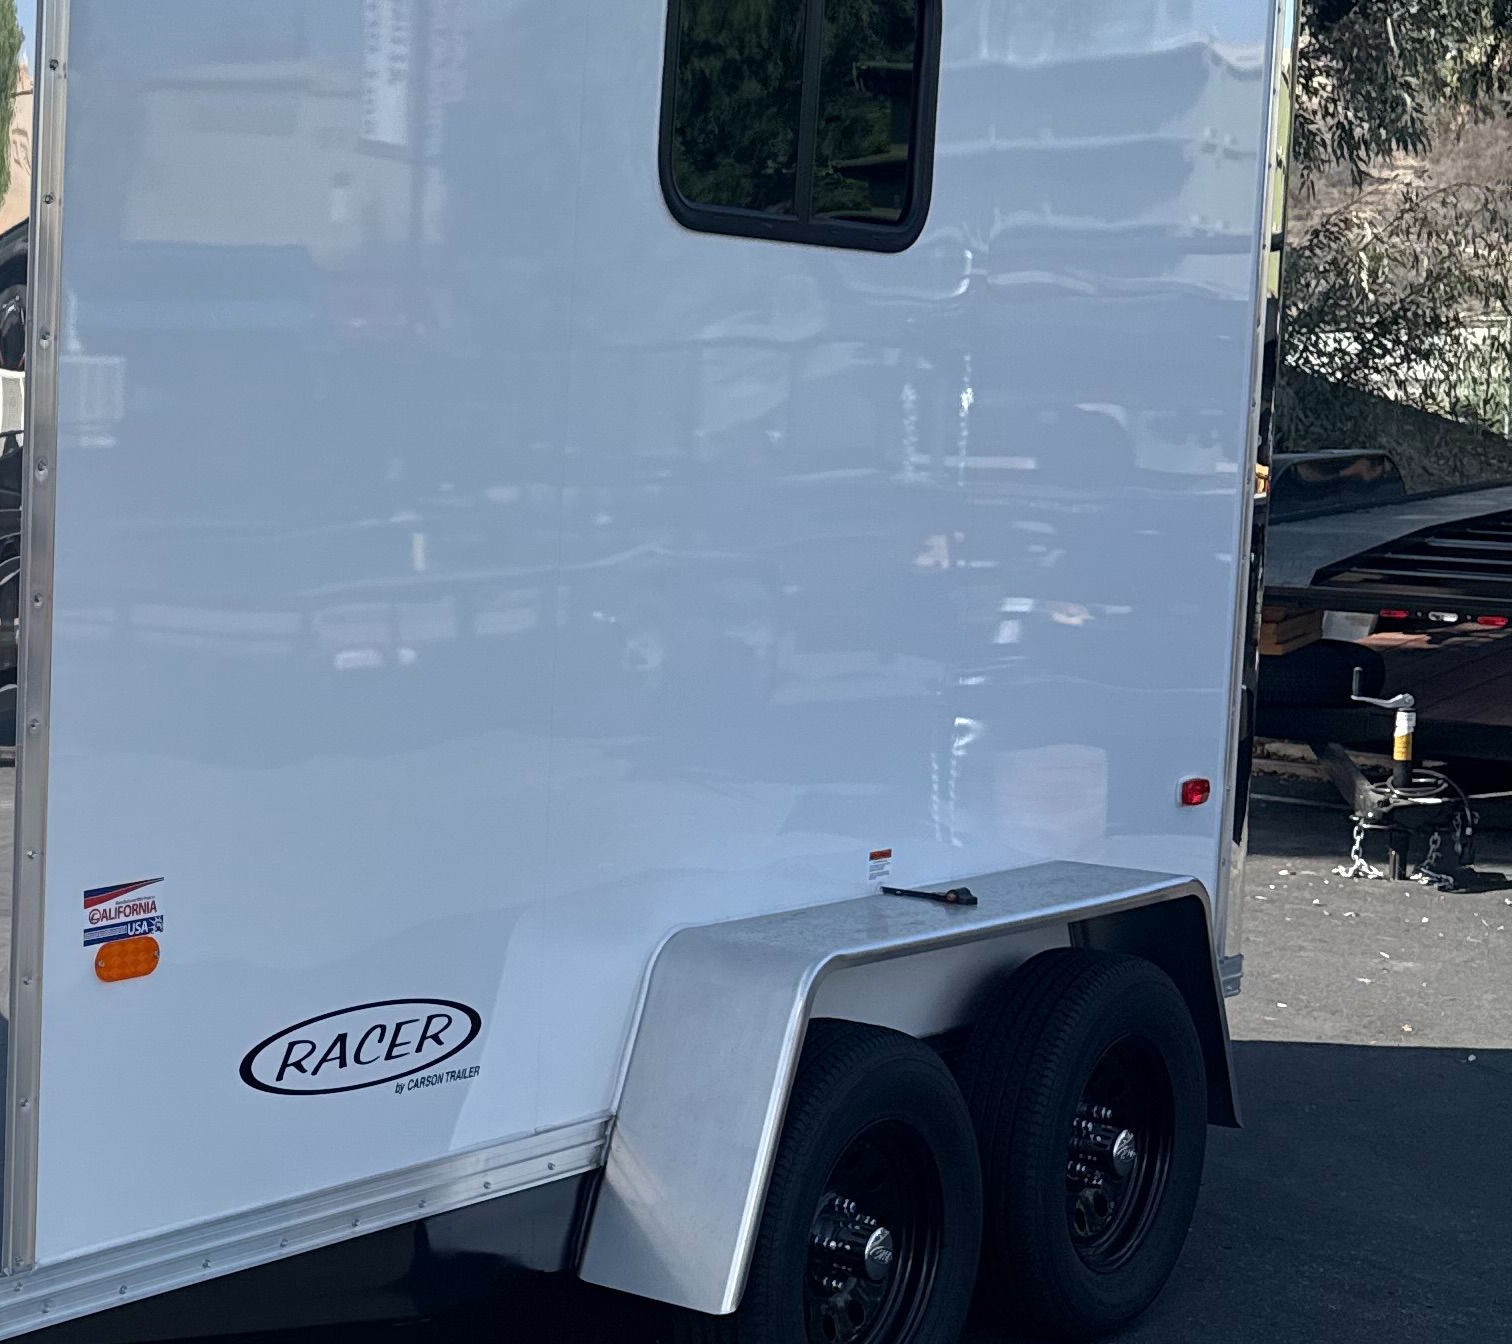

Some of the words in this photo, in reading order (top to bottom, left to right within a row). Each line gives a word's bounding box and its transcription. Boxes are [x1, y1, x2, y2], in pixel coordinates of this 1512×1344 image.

[89, 900, 158, 925] CALIFORNIA
[127, 920, 149, 936] USA
[275, 1013, 453, 1082] RACER
[395, 1082, 405, 1094] by
[407, 1073, 445, 1091] CARSON
[445, 1065, 480, 1083] TRAILER
